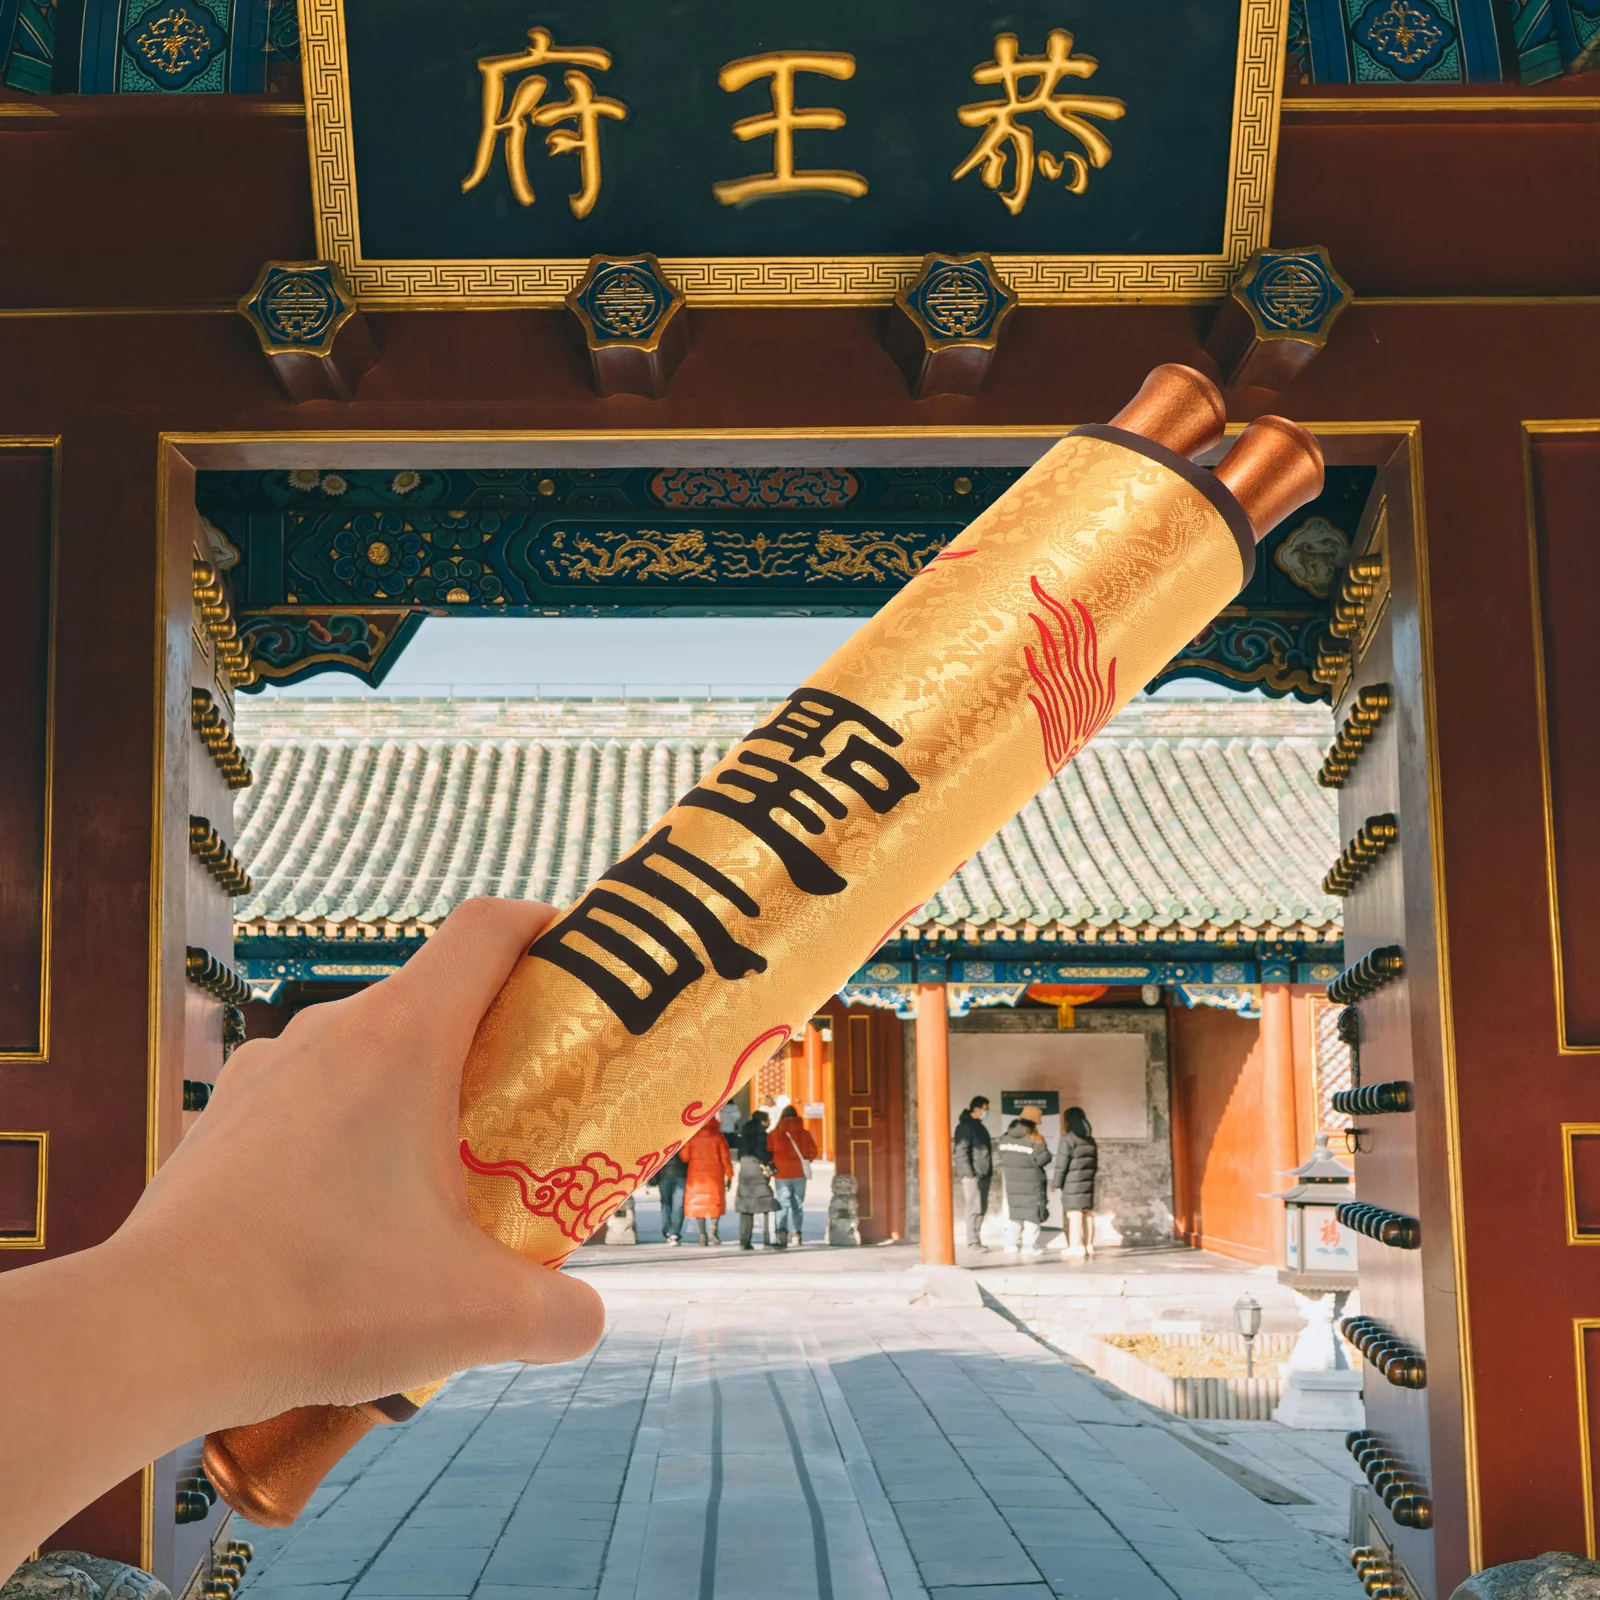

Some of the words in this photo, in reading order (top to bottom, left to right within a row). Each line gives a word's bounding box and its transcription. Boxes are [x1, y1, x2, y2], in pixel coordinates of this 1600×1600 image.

[461, 26, 1126, 218] 恭王府
[528, 687, 920, 1035] 聖旨
